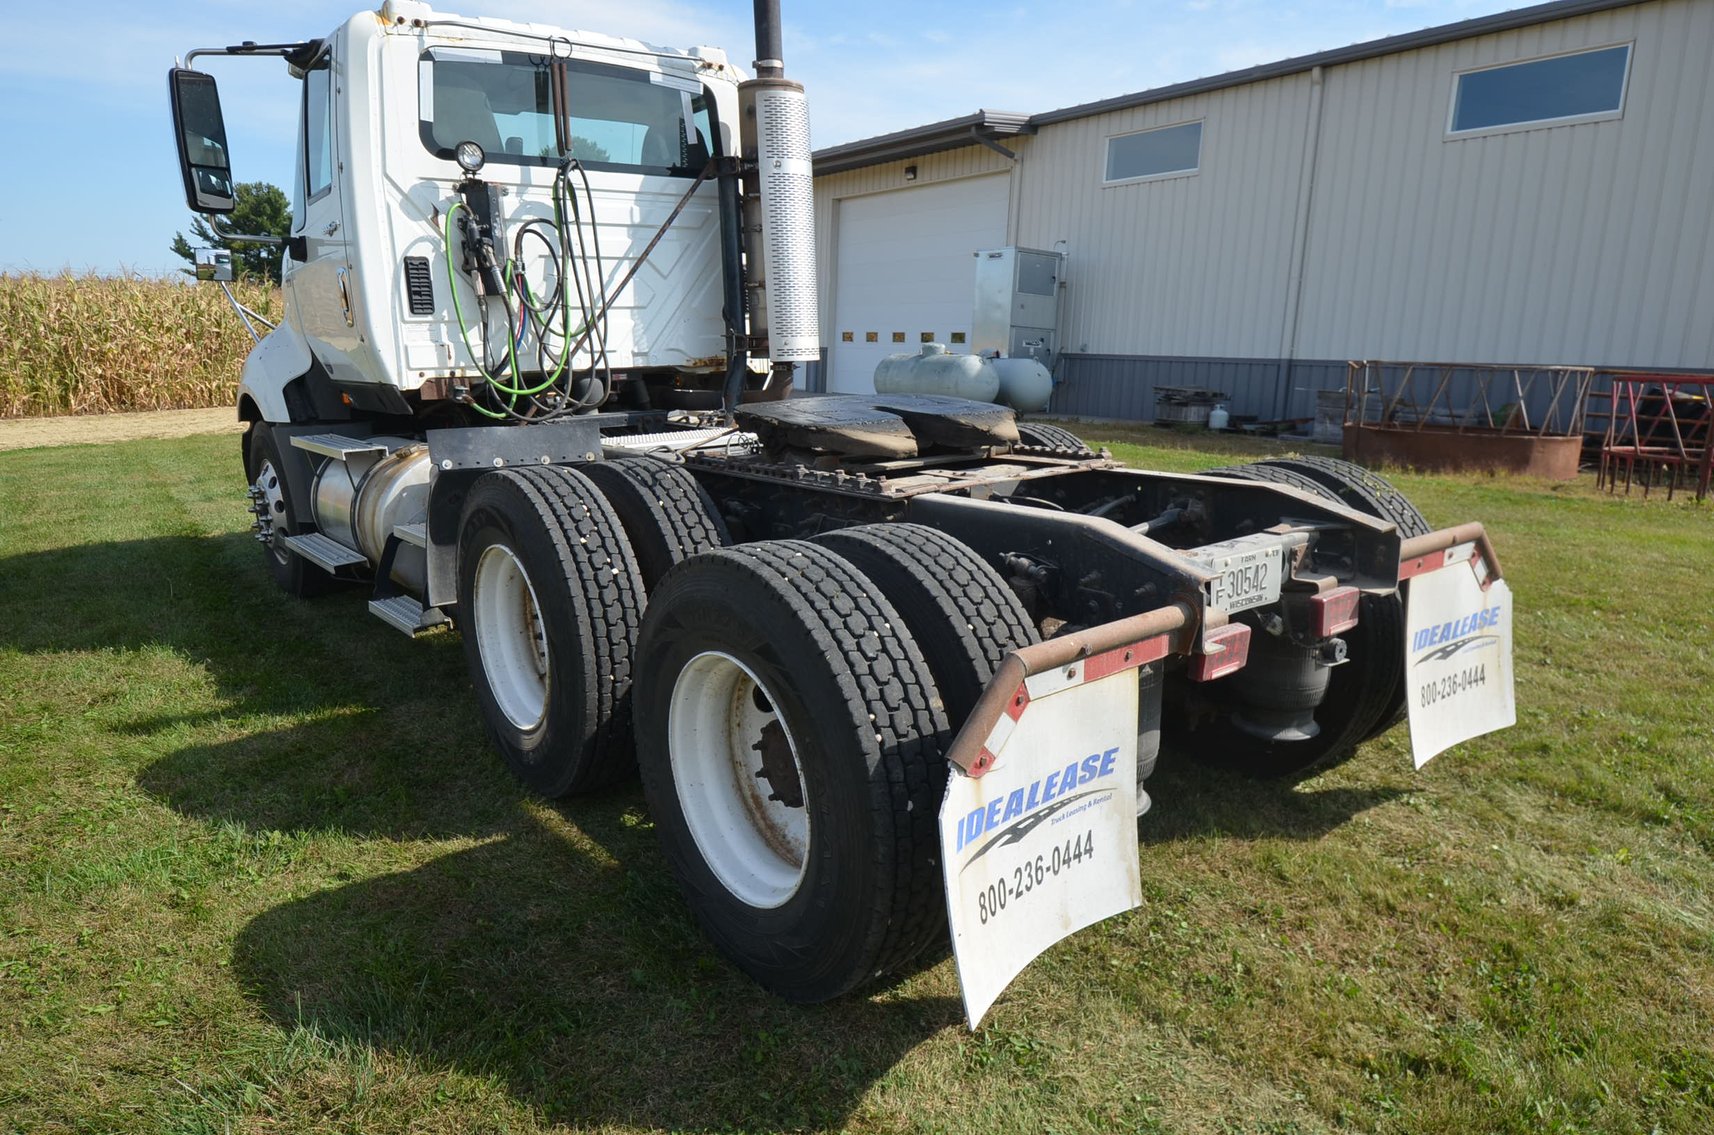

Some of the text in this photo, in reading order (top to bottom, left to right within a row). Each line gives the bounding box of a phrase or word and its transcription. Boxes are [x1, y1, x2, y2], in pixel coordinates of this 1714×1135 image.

[1229, 594, 1263, 609] WISCONSIN
[1412, 606, 1501, 653] IDEALEASE
[1420, 663, 1486, 708] 800-236-0444
[956, 746, 1120, 853] IDEALEASE
[1051, 792, 1113, 826] Truck Leasing & Rental
[978, 829, 1095, 925] 800-236-0444
